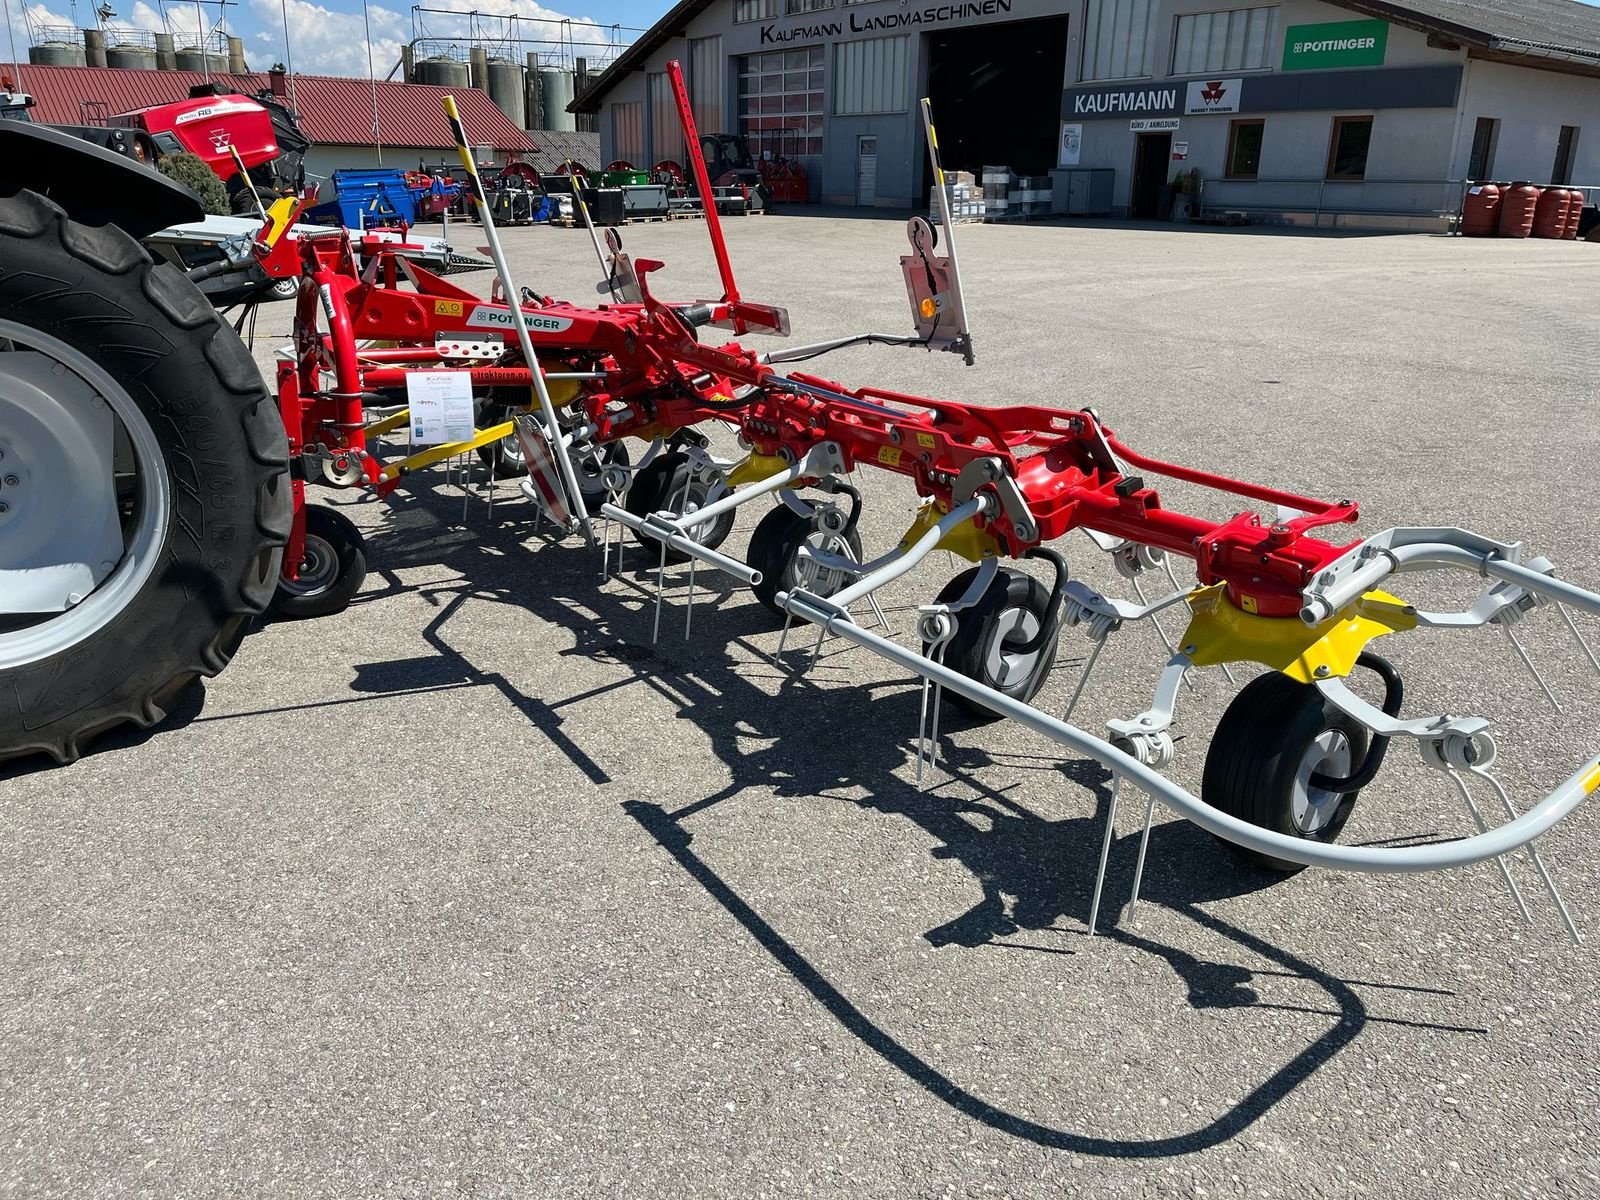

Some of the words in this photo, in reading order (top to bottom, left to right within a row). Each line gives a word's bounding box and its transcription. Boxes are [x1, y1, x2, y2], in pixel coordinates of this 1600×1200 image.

[760, 22, 842, 45] KAUFMANN
[849, 0, 1012, 33] LANDMASCHINEN
[1075, 89, 1176, 113] KAUFMANN
